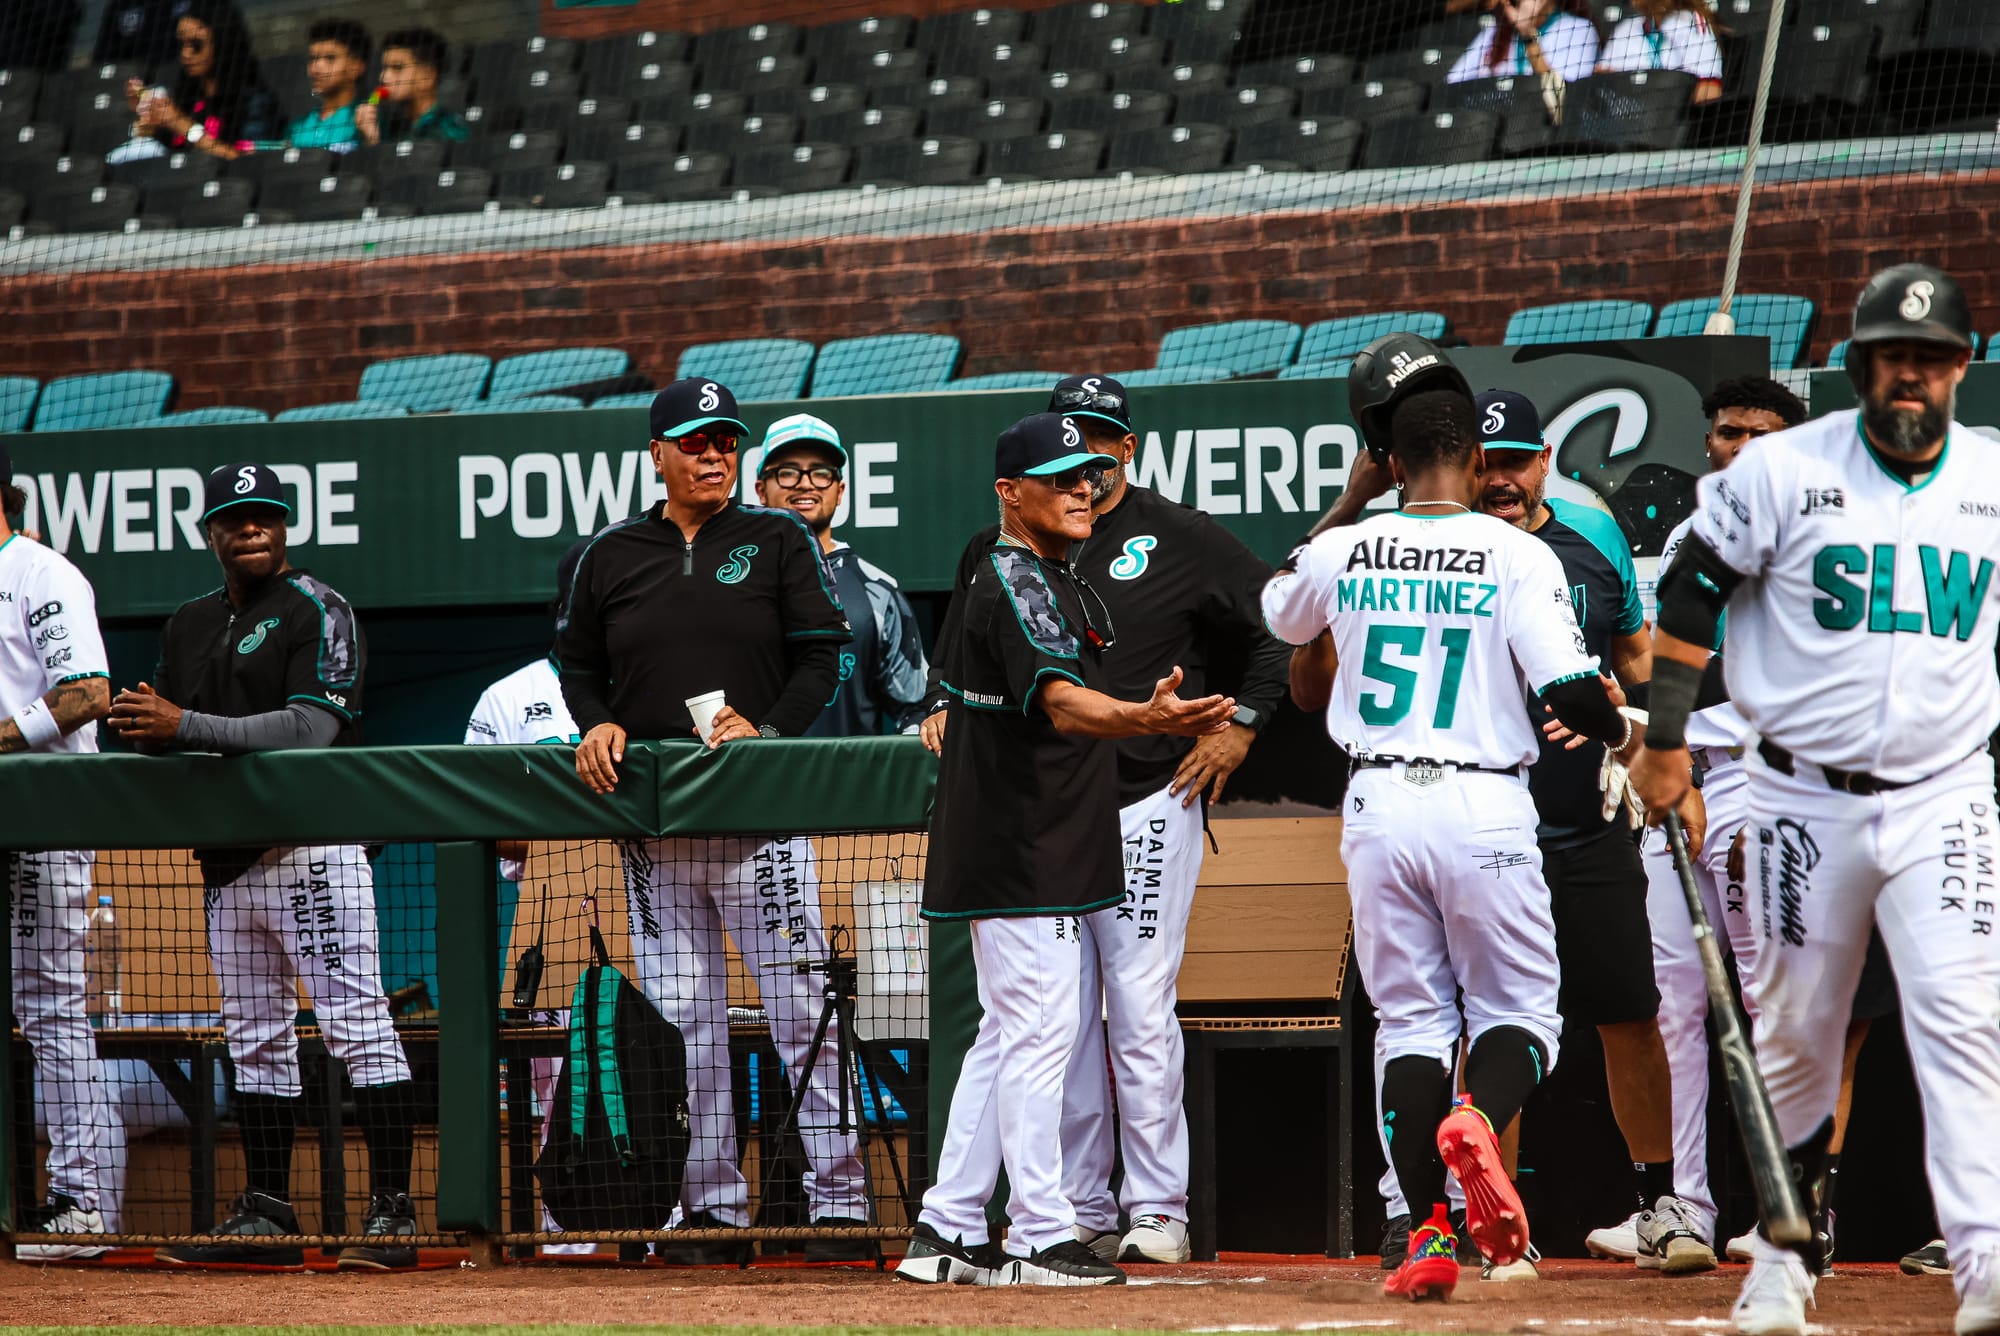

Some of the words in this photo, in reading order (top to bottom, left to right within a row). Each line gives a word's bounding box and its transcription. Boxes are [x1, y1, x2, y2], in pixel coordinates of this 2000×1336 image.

[699, 382, 720, 412] S
[1385, 354, 1438, 388] Alianza
[1391, 351, 1412, 368] 51
[1061, 416, 1080, 447] S
[1482, 402, 1507, 434] S
[234, 466, 256, 494] S
[1959, 501, 2000, 518] SIMS
[1346, 536, 1486, 576] Alianza
[1812, 543, 1995, 642] SLW
[1337, 578, 1498, 618] MARTINEZ
[1358, 624, 1472, 729] 51
[752, 848, 783, 935] TRUCK
[774, 836, 807, 947] DAIMLER
[1116, 835, 1144, 922] TCK
[1138, 818, 1166, 940] DAIMLER
[1776, 818, 1823, 948] Caliente
[1969, 801, 1995, 937] DAIMLER
[287, 878, 317, 959] TRUCK
[308, 860, 342, 972] DAIMLER
